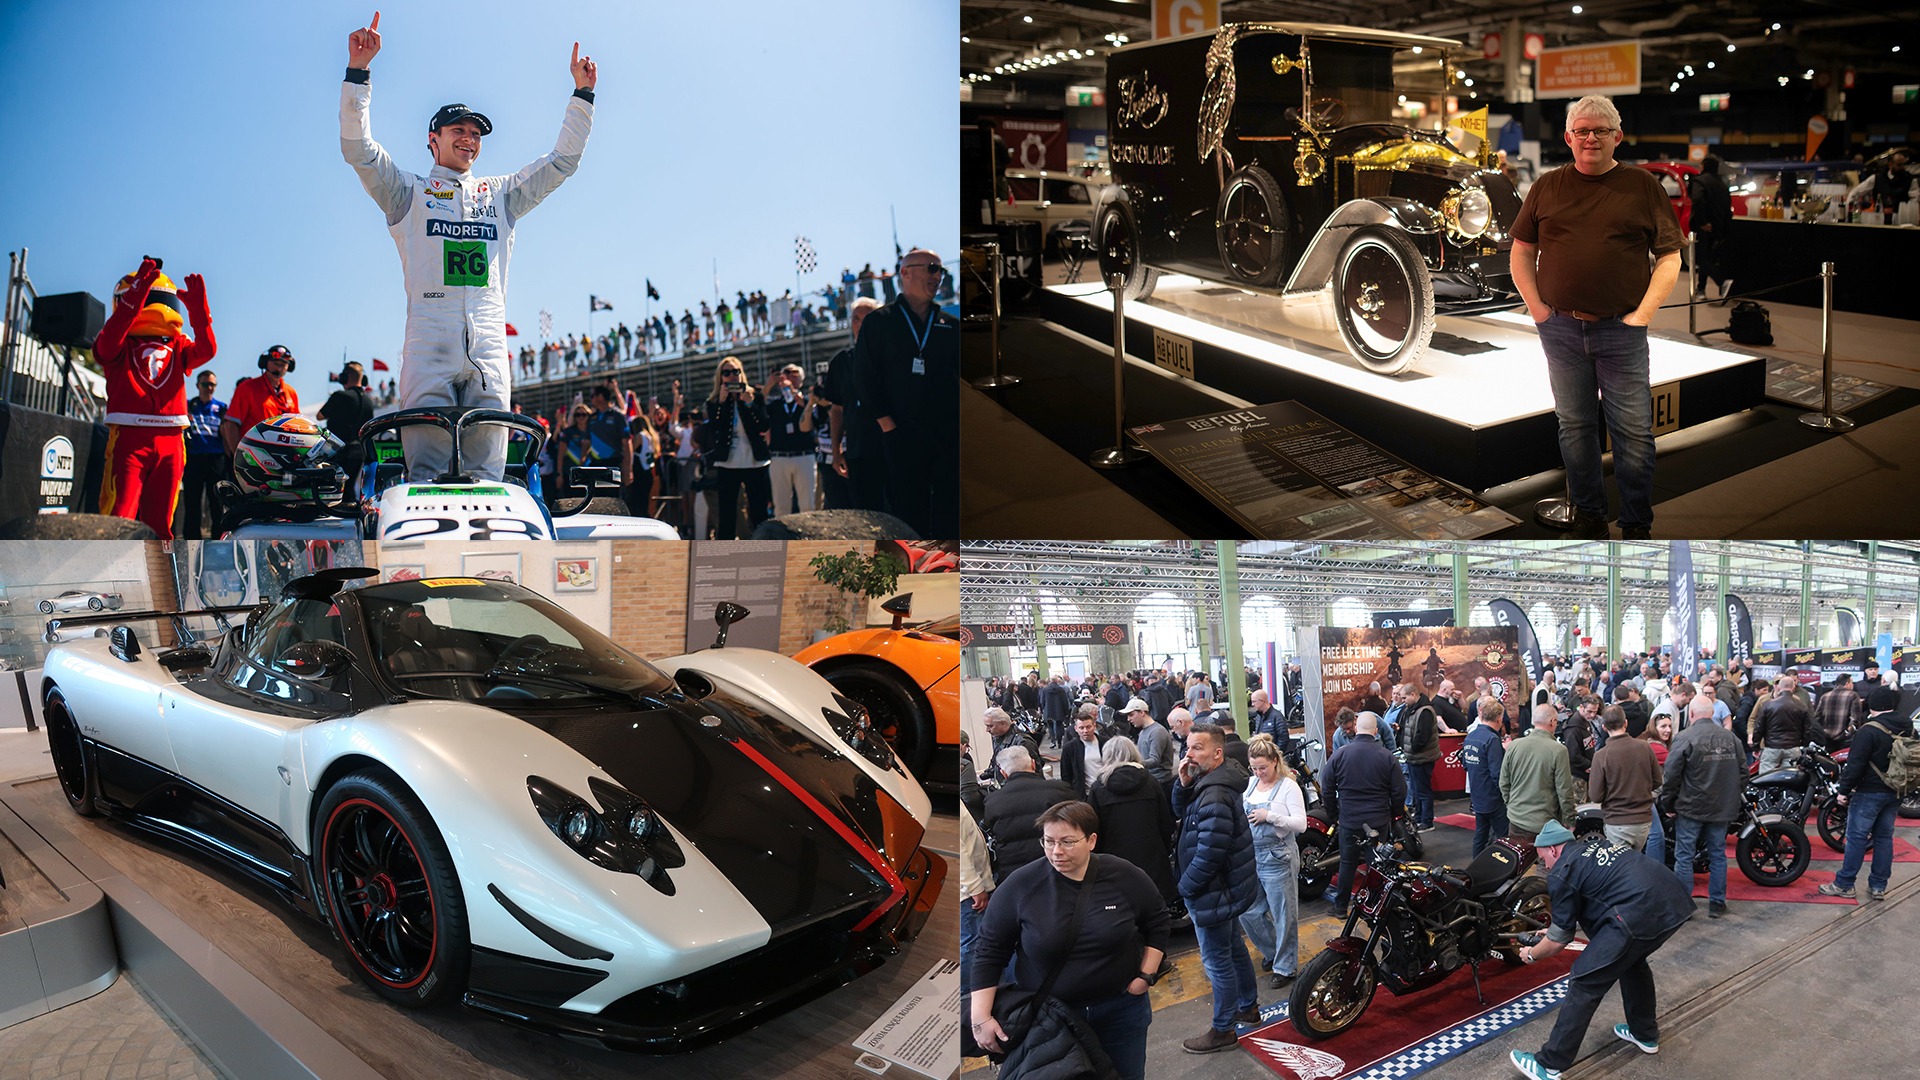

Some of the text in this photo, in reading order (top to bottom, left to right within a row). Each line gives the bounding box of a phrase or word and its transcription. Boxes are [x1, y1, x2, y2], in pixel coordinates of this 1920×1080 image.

[1170, 0, 1204, 37] G
[1460, 117, 1487, 131] NYHET
[432, 222, 494, 238] ANDRETTI
[447, 251, 486, 276] RG
[423, 291, 445, 299] sparco
[57, 455, 72, 470] NTT
[40, 480, 73, 496] INDYCAR
[982, 624, 998, 633] DIT
[1399, 618, 1420, 627] BMW
[1321, 647, 1381, 659] FREE LIFETIME
[1485, 644, 1504, 654] INDIAN
[1322, 662, 1377, 676] MEMBERSHIP.
[1323, 680, 1355, 693] JOIN US.
[868, 1031, 888, 1047] ZONDA
